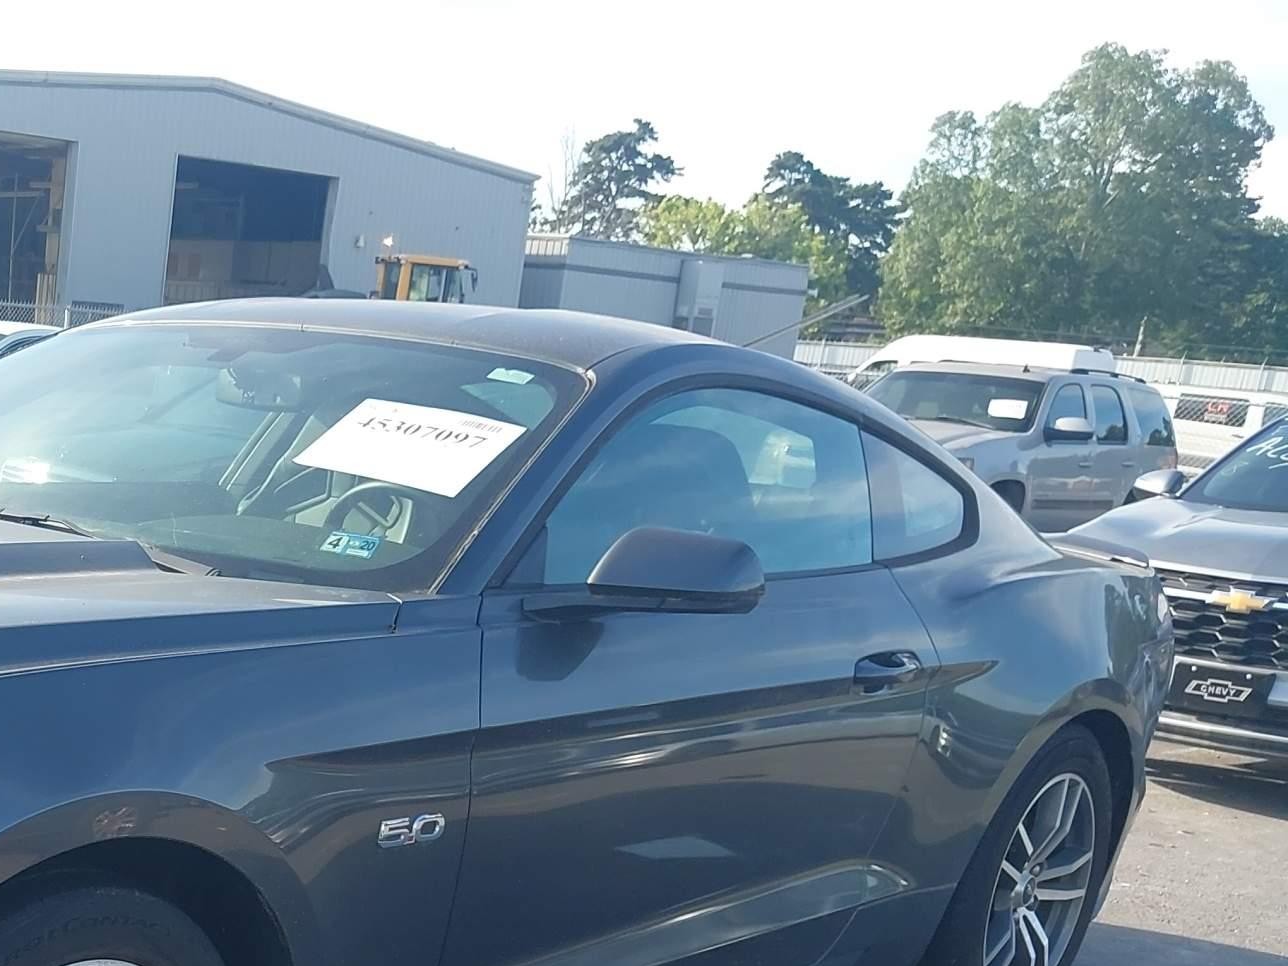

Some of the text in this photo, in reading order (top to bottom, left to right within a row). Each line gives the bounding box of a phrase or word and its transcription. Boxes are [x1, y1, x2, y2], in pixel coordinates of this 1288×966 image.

[358, 417, 489, 449] 45307097
[327, 536, 344, 549] 4
[1200, 684, 1238, 697] CHEVY
[377, 812, 446, 849] 5.0
